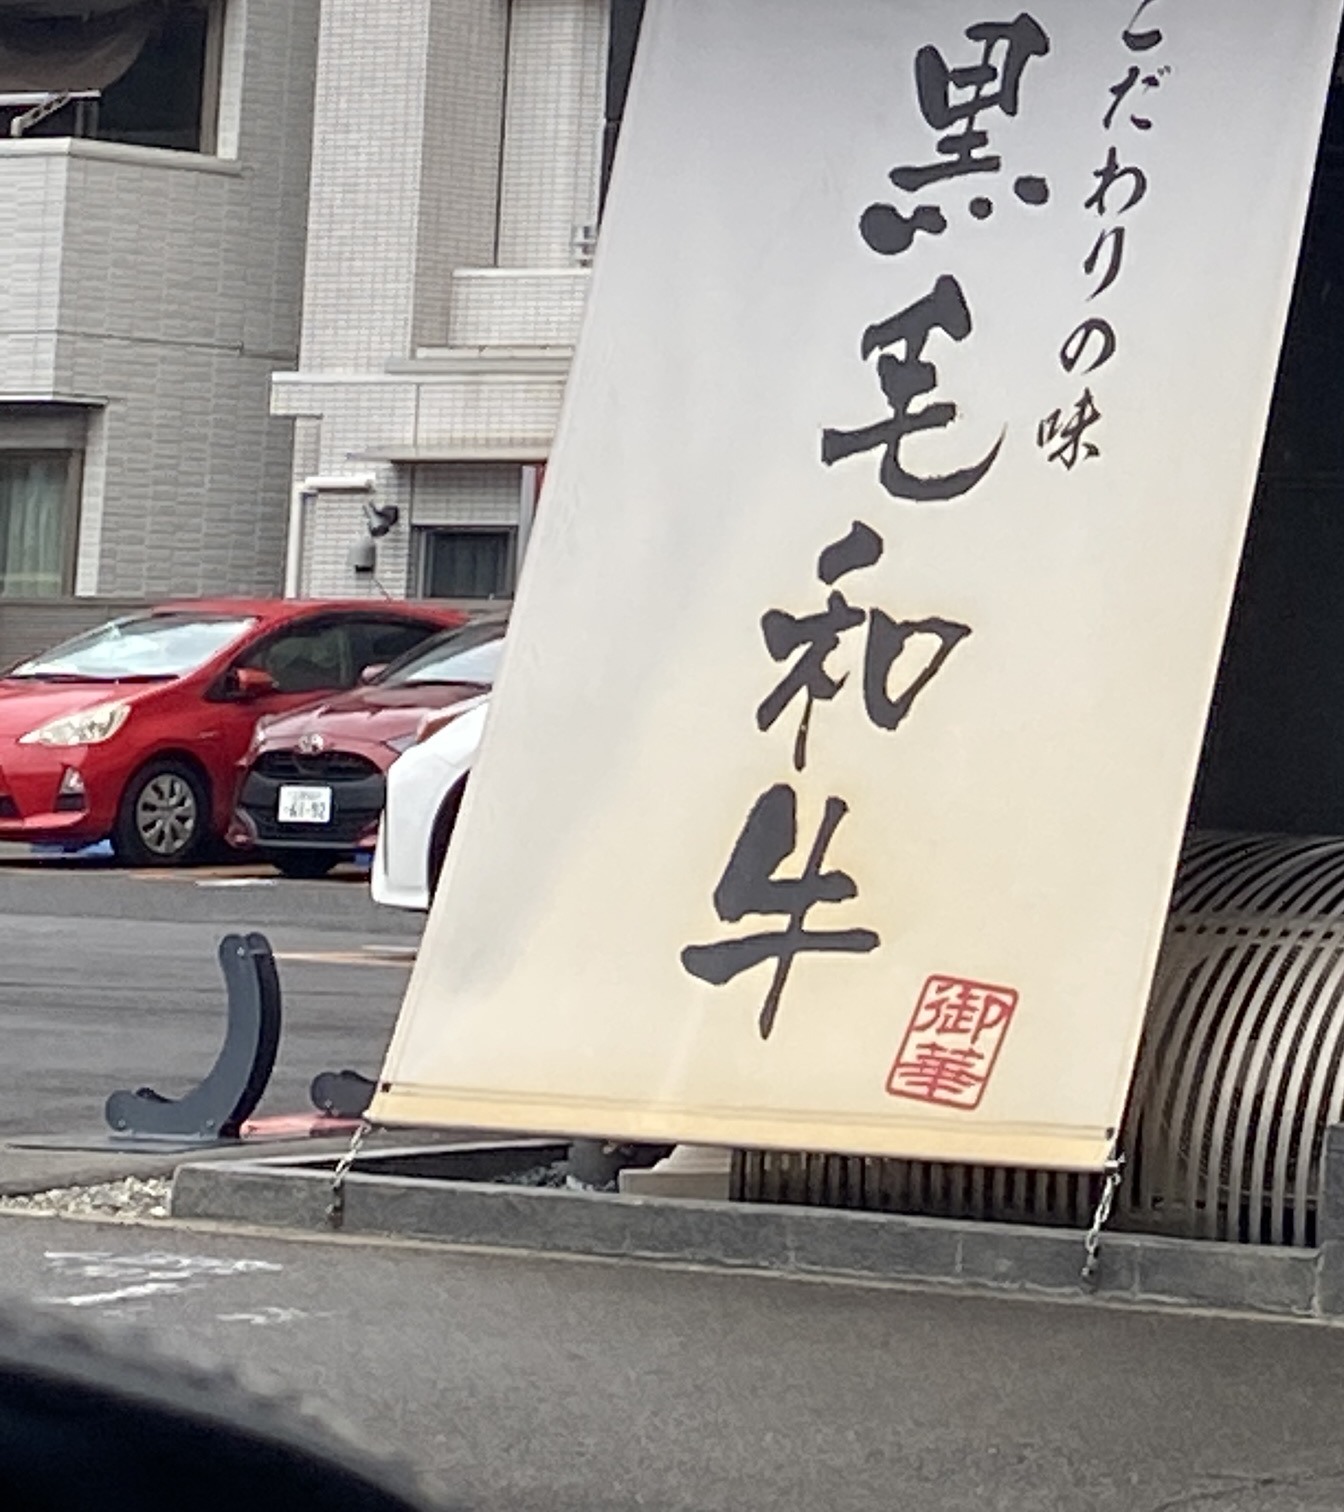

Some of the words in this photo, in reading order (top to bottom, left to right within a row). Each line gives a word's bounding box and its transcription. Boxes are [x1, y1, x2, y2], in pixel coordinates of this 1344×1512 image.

[680, 12, 1051, 1041] 黒毛和牛
[898, 980, 1011, 1101] 御華
